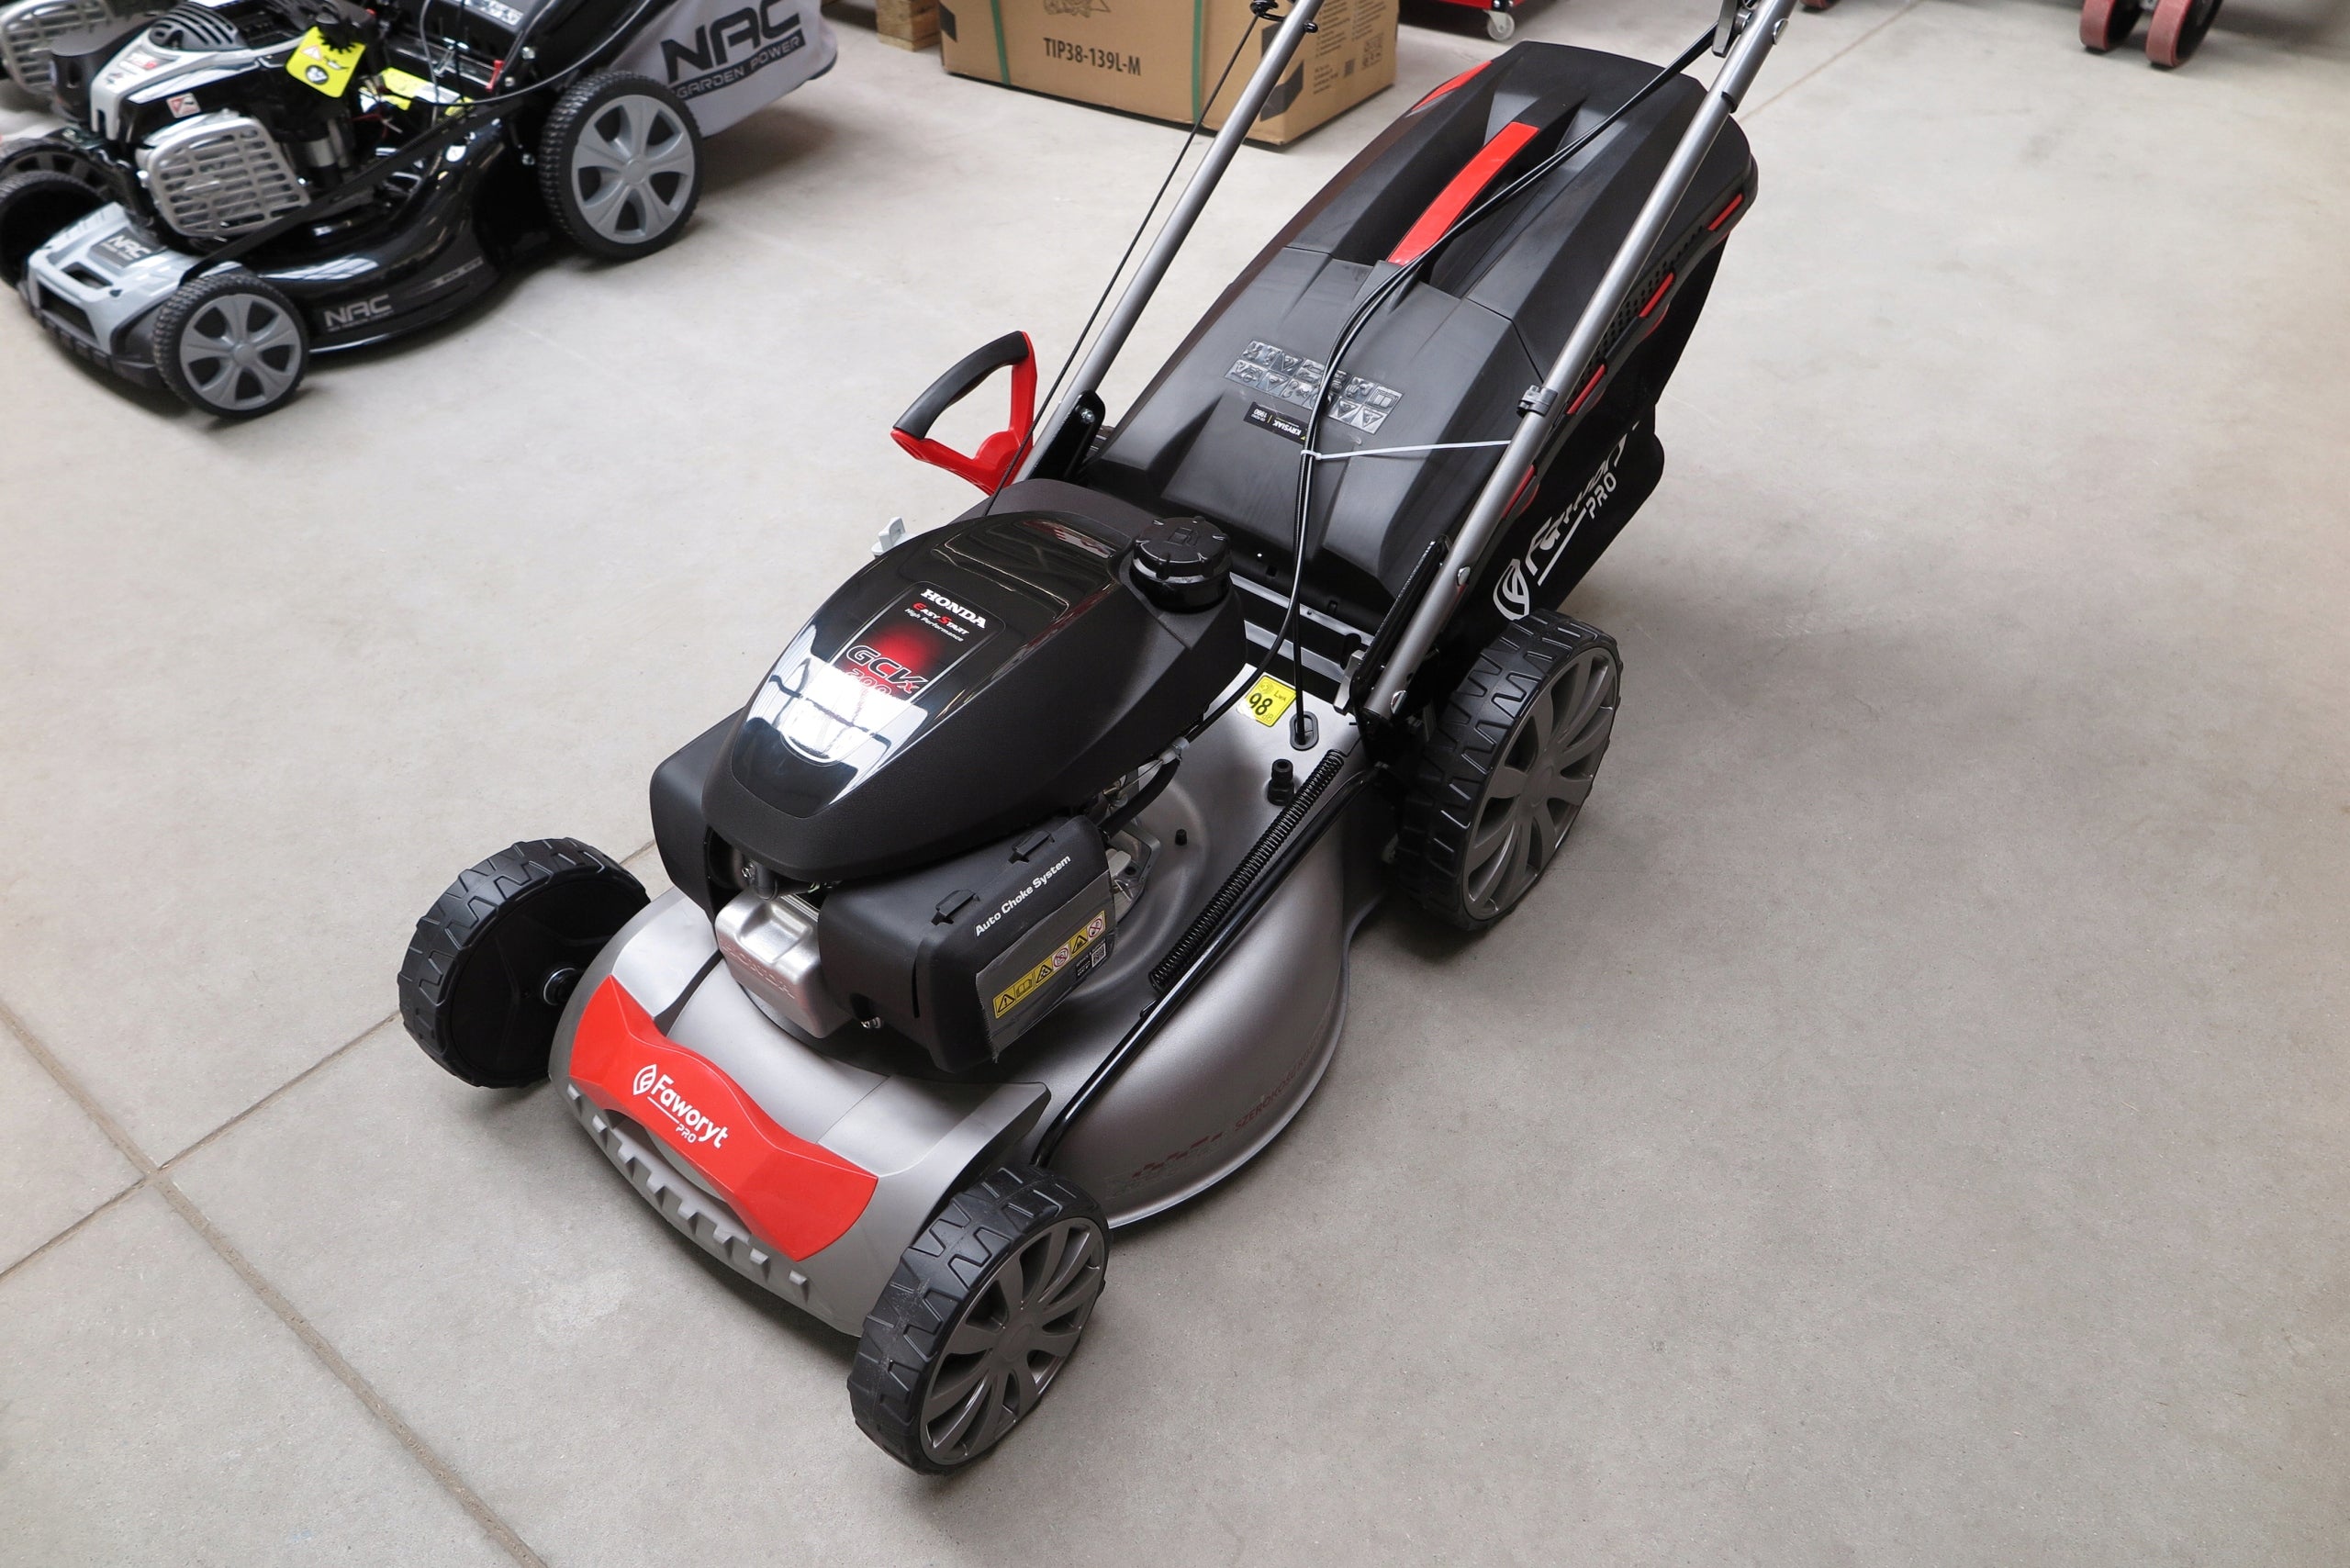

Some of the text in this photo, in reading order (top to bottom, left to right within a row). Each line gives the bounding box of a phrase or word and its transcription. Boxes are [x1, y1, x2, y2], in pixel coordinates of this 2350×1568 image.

[661, 0, 800, 84] NAC
[1043, 37, 1141, 76] TIP38-139L-M
[677, 36, 800, 98] GARDEN POWER
[324, 294, 392, 327] NAC
[1272, 420, 1302, 436] KRYSIAK
[1585, 472, 1617, 520] PRO
[920, 588, 987, 629] HONDA
[1249, 692, 1273, 716] 98
[974, 855, 1072, 937] Auto Choke System
[650, 1073, 729, 1149] Faworyt
[675, 1123, 698, 1144] PRO
